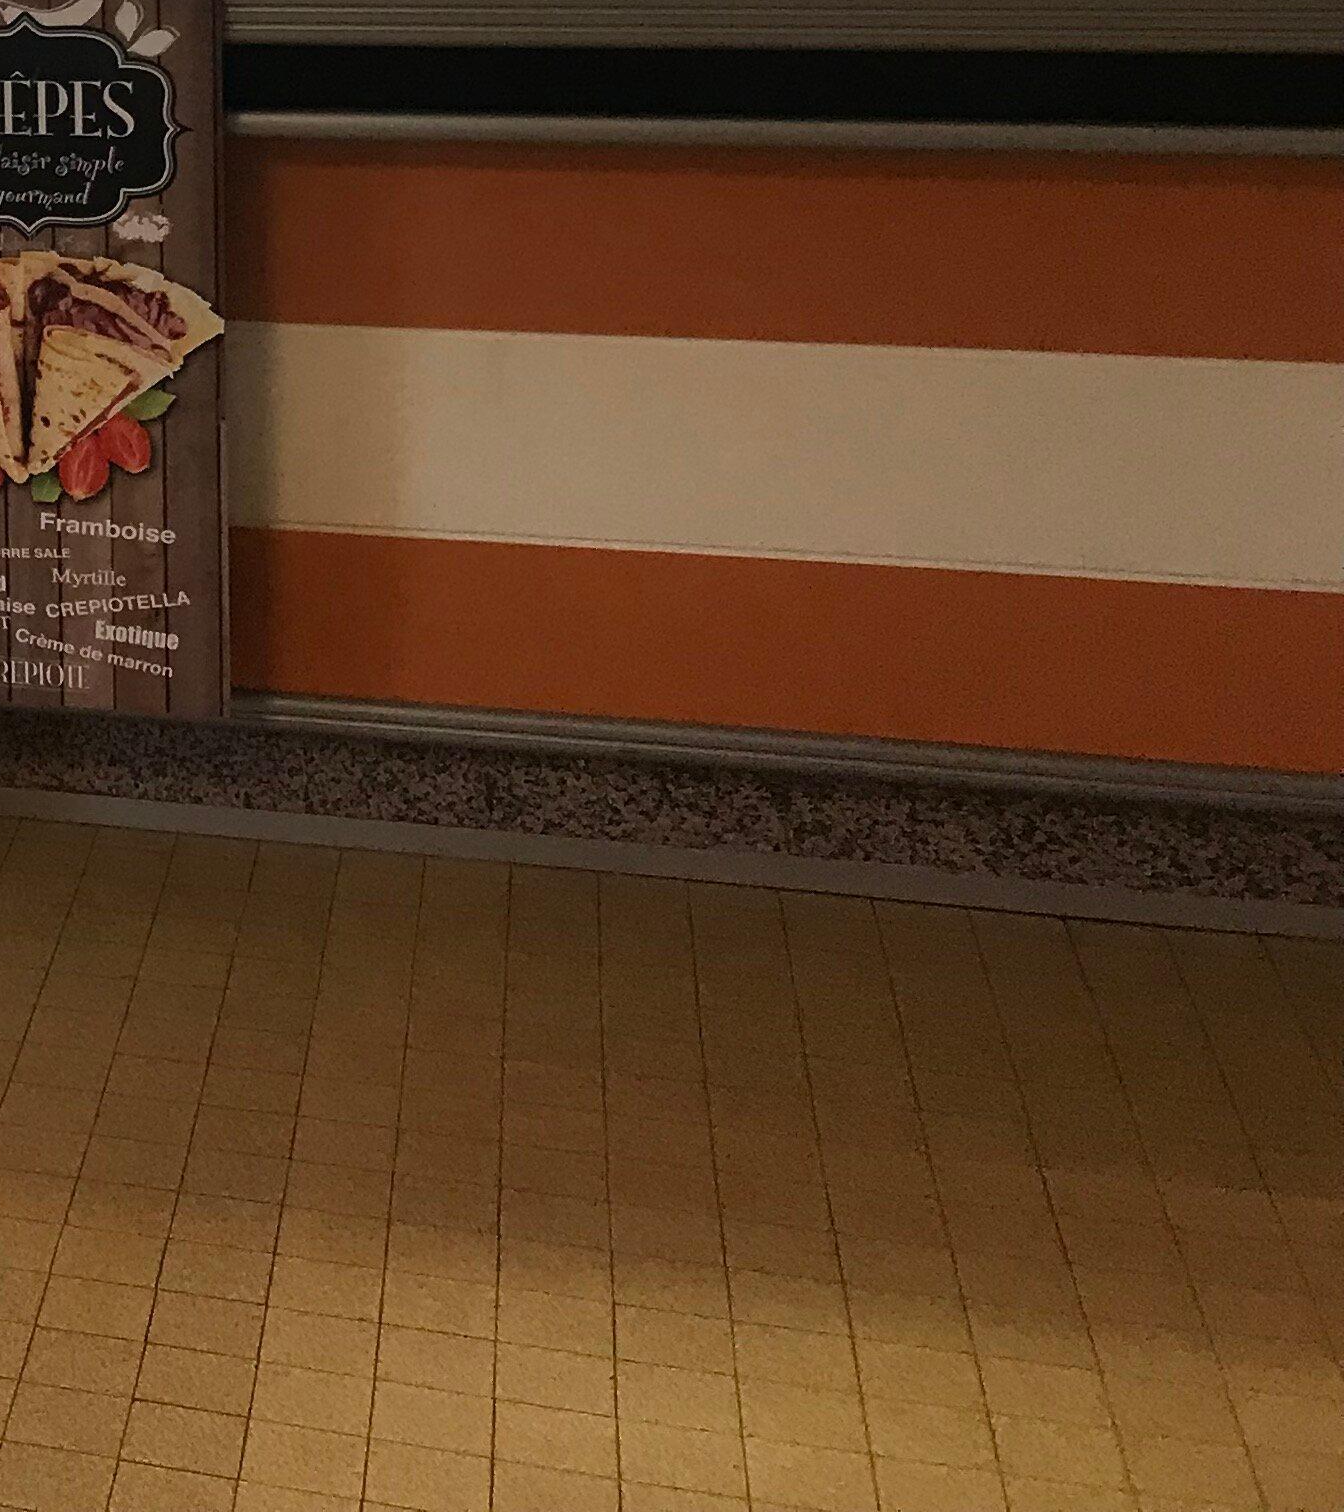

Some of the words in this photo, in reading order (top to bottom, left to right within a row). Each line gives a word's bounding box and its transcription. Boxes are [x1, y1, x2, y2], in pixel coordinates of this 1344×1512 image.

[55, 146, 125, 181] simple
[39, 512, 177, 544] Framboise
[34, 547, 71, 559] SALE
[51, 568, 127, 588] Myrtille
[45, 590, 191, 618] CREPIOTELLA
[95, 619, 179, 650] Exotique
[15, 628, 75, 655] Crème
[80, 645, 103, 661] de
[107, 653, 173, 678] marron
